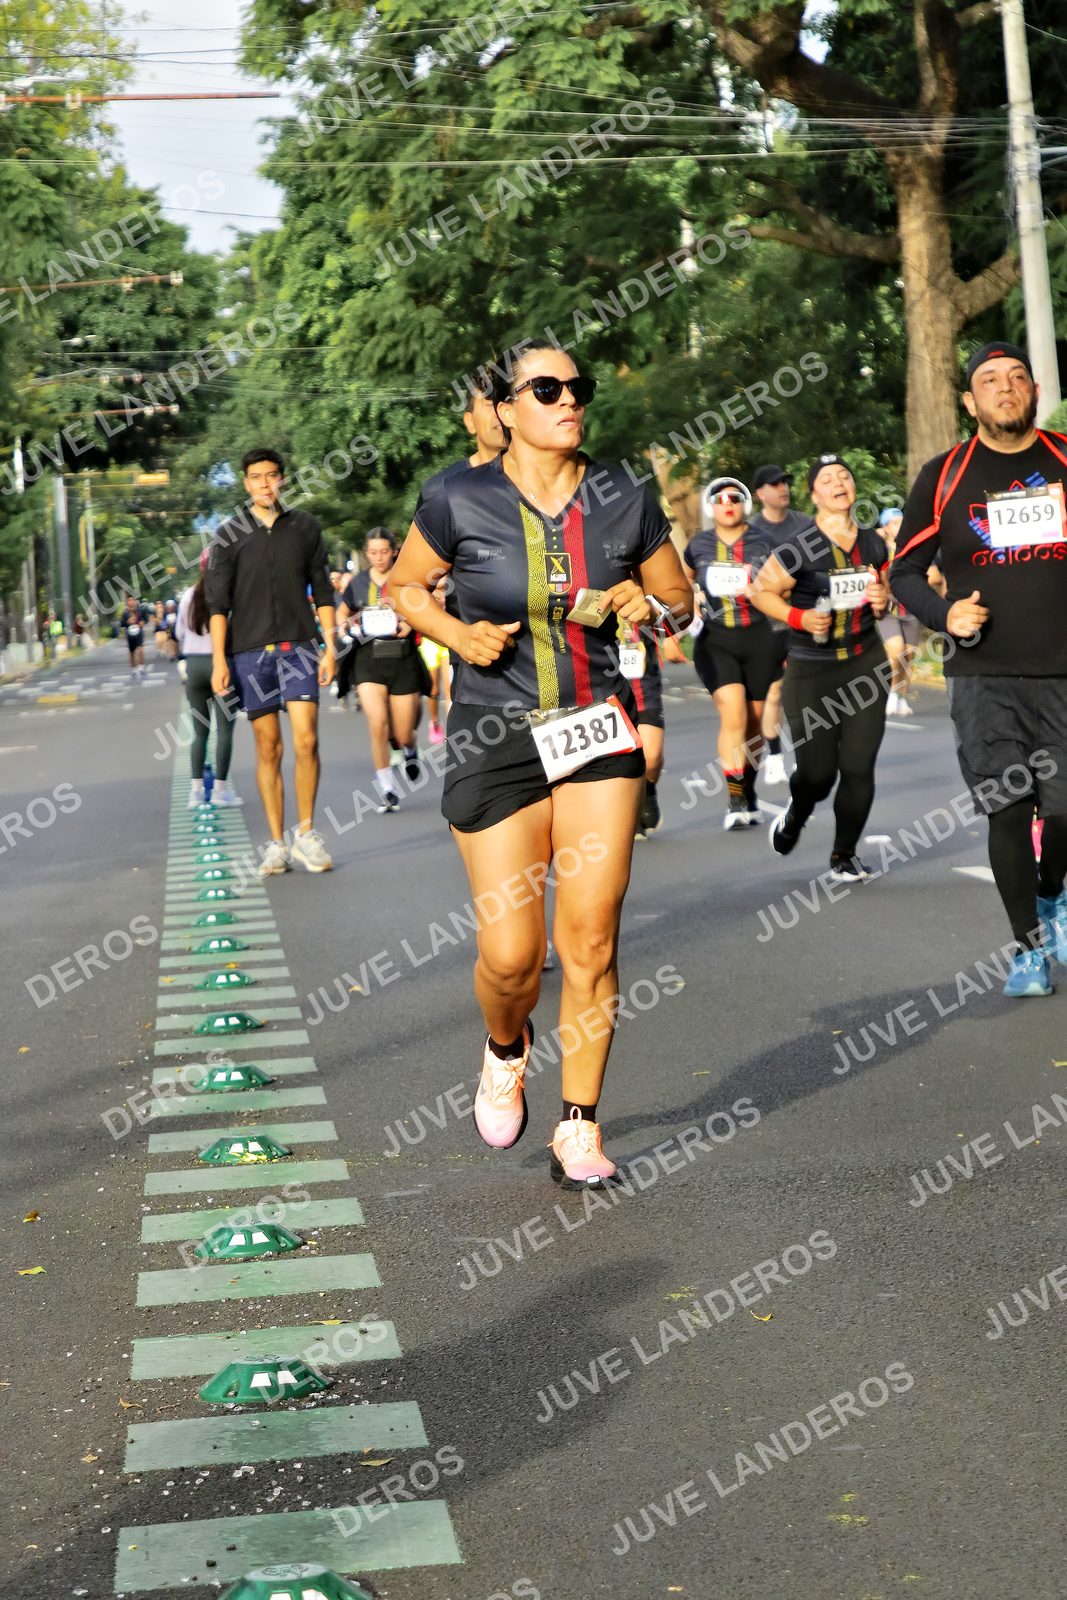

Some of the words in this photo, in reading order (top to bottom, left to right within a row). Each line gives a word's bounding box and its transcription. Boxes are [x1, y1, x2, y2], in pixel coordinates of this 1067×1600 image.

[994, 503, 1055, 526] 12659
[834, 580, 869, 595] 1230
[542, 711, 618, 760] 12387
